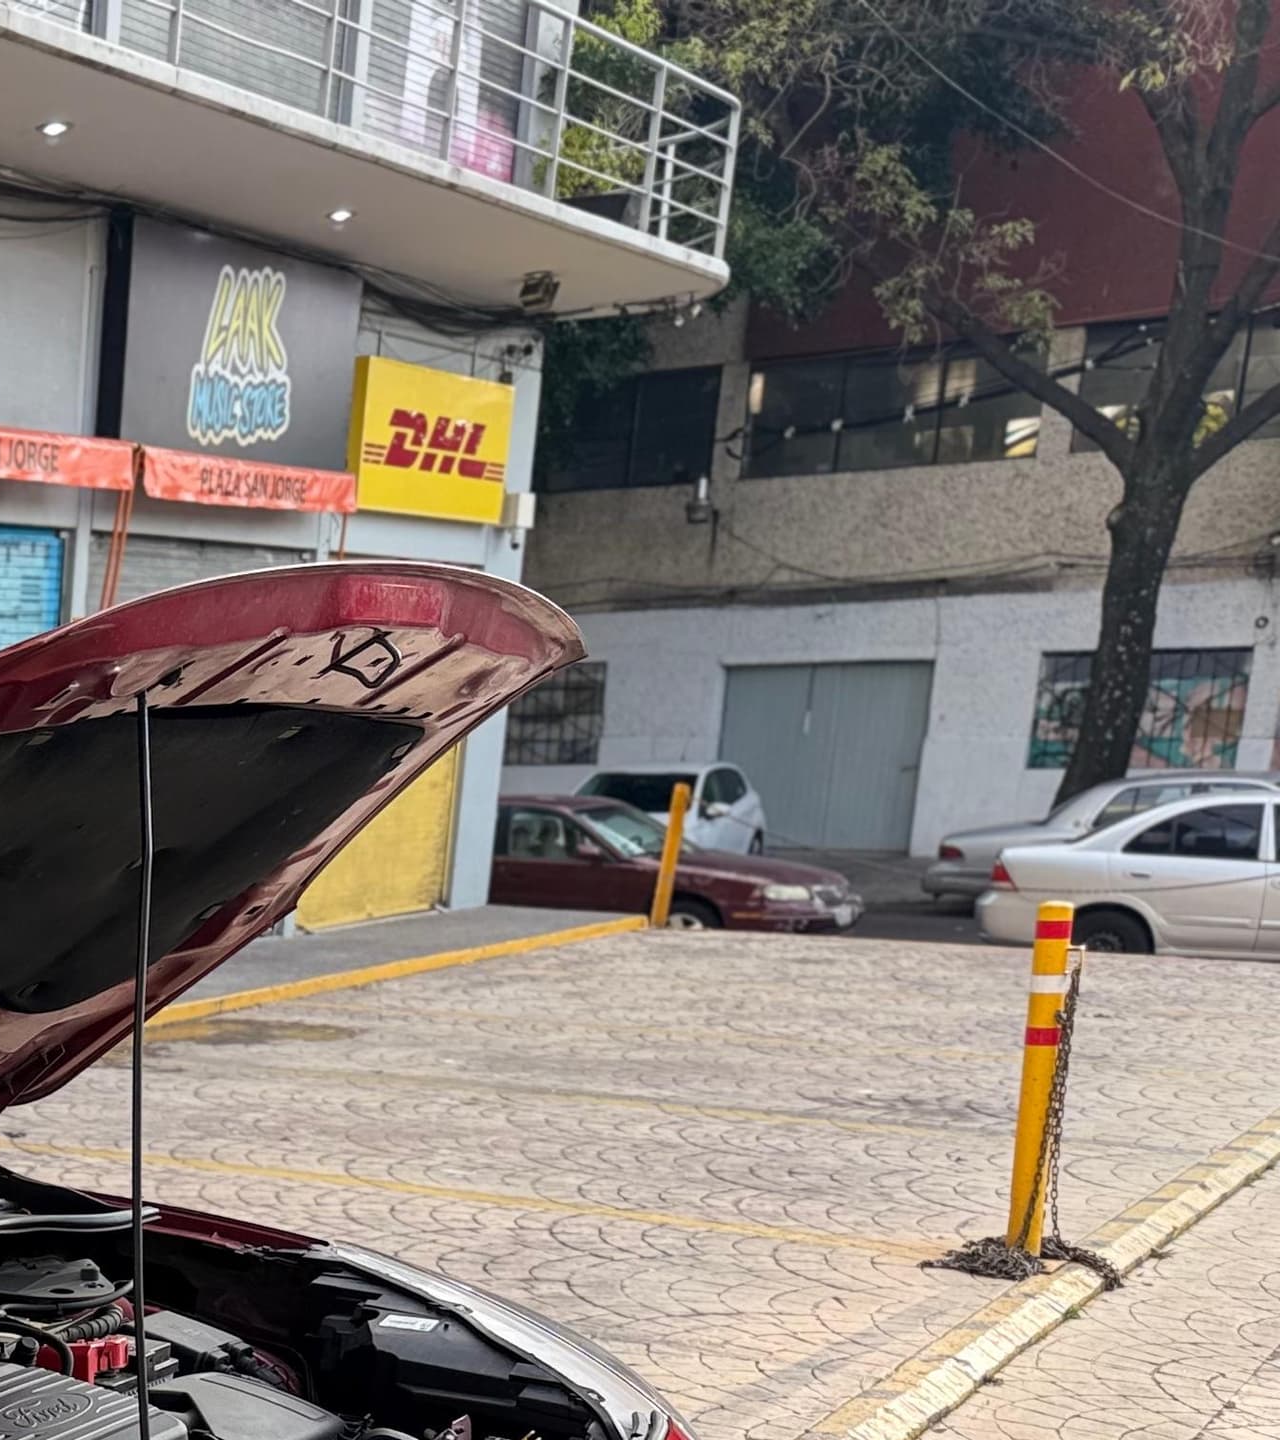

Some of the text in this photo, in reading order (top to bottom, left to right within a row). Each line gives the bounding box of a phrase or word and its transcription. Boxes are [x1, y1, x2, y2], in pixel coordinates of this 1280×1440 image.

[3, 441, 60, 473] JORGE
[384, 408, 487, 480] DHL
[200, 468, 307, 501] PLAZA SAN JORGE
[3, 1396, 82, 1429] Ford
